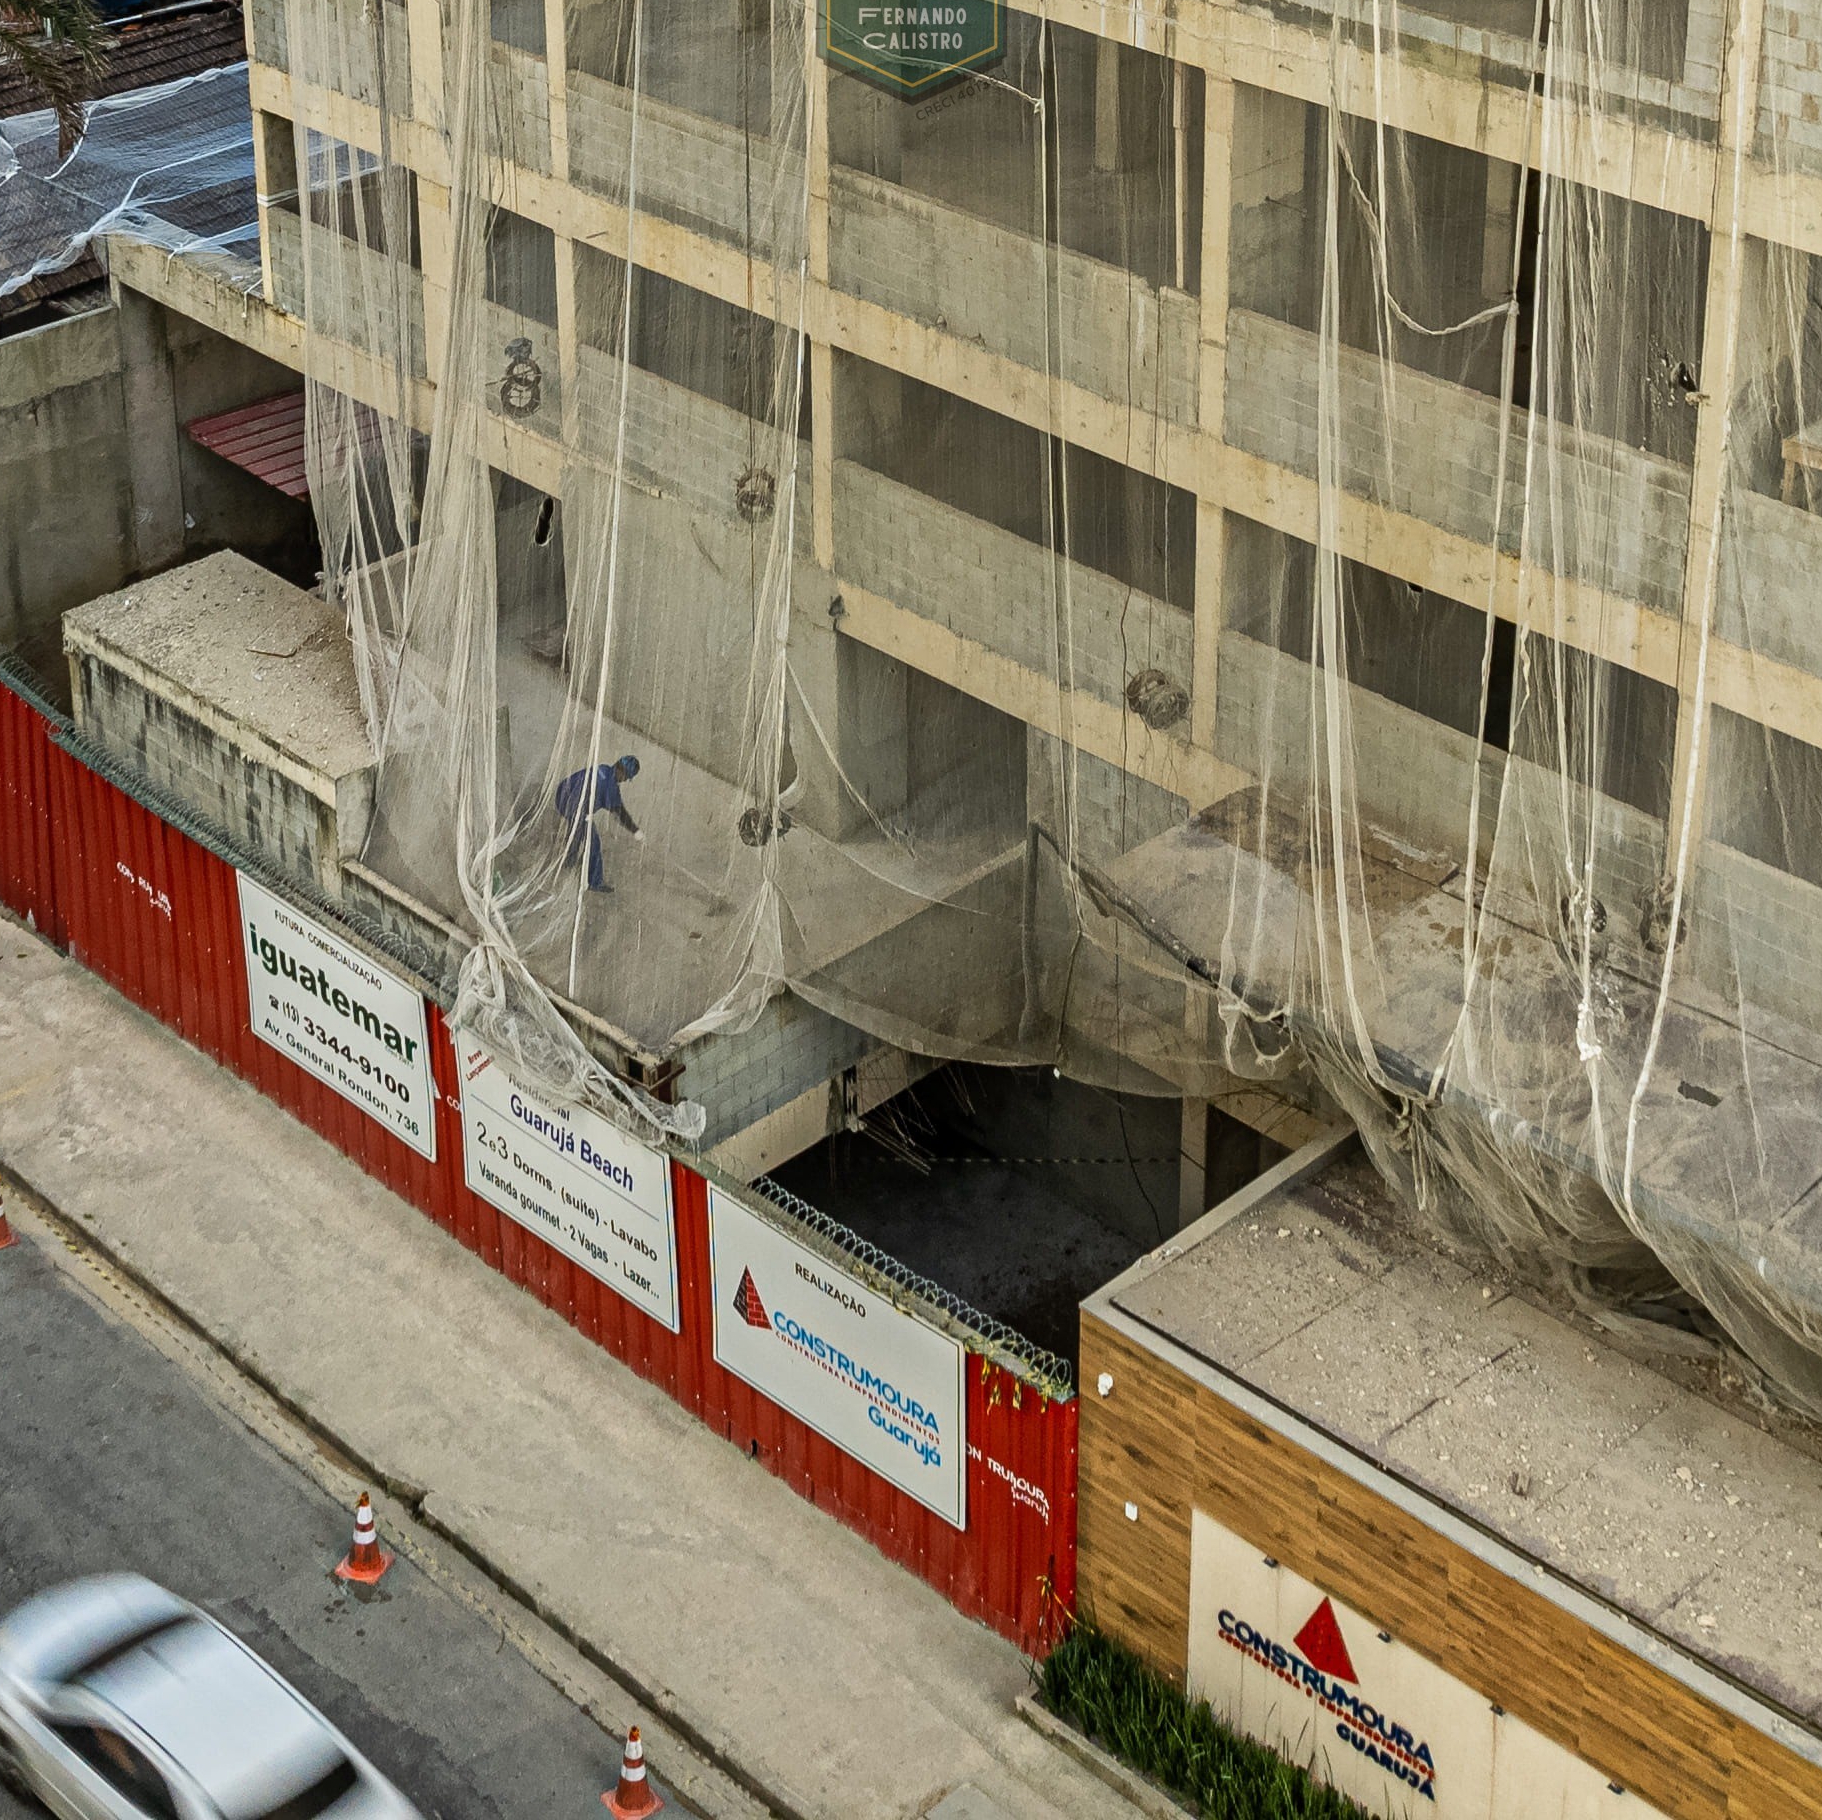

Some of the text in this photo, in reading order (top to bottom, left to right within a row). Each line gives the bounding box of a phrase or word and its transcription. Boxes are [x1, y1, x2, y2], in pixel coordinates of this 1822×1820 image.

[249, 923, 418, 1062] iguatemar
[274, 909, 383, 991] FUTURA COMERCIALIZAÇÃO
[264, 1018, 420, 1136] Av. General Rondon, 736
[282, 1000, 300, 1026] (13)
[304, 1015, 410, 1103] 3344-9100
[509, 1094, 634, 1193] Guarujá Beach
[478, 1160, 519, 1201] Varanda
[519, 1192, 562, 1232] gourmet
[569, 1227, 577, 1242] 2
[576, 1229, 609, 1264] Vagas
[513, 1152, 557, 1195] Dorms.
[610, 1219, 658, 1262] Lavabo
[794, 1262, 867, 1319] REALIZAÇÃO
[773, 1311, 939, 1435] CONSTRUMOURA
[775, 1331, 841, 1380] CONSTRUTORA
[847, 1379, 941, 1445] EMPREENDIMENTOS
[868, 1405, 942, 1467] Guarujá
[1217, 1609, 1435, 1771] CONSTRUMOURA
[1218, 1628, 1301, 1690] CONSTRUTORA
